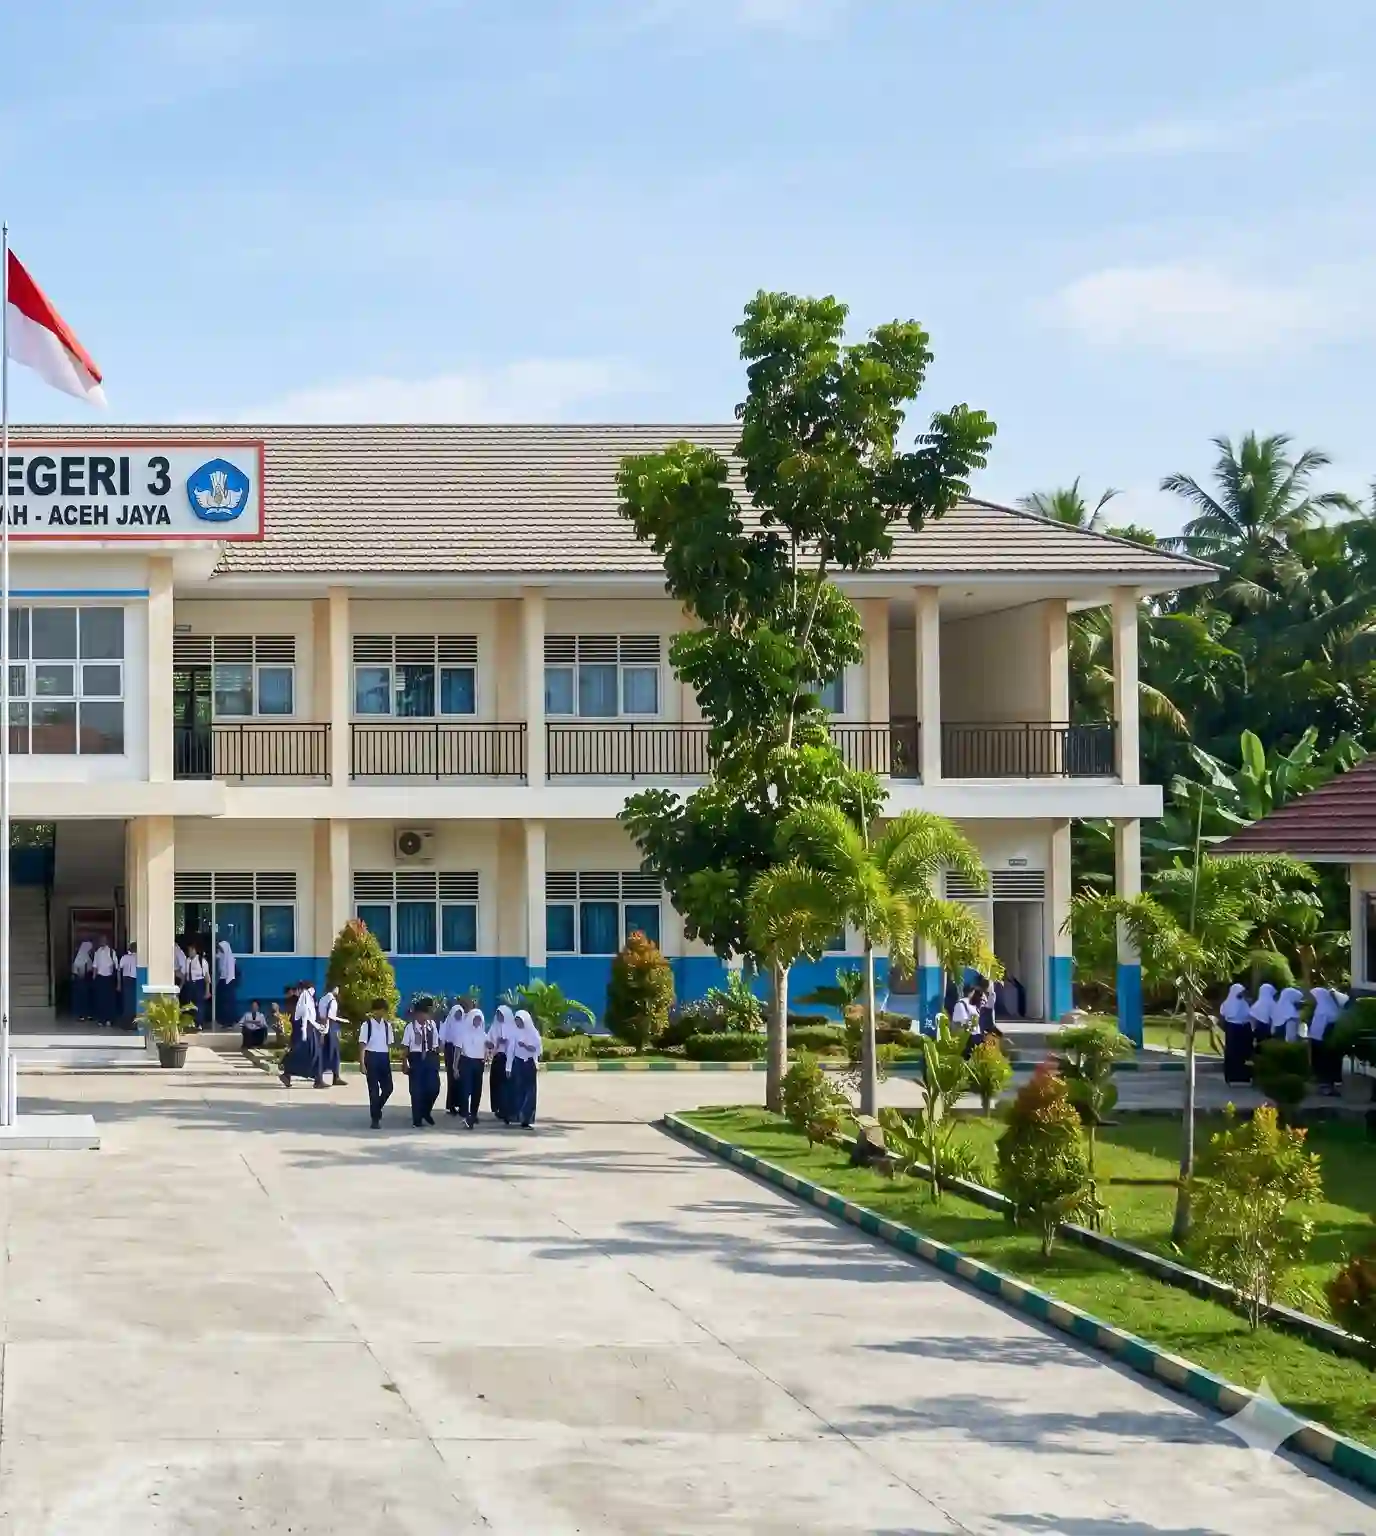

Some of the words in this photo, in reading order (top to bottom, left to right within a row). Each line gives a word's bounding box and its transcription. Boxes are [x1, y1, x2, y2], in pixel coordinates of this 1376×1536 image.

[147, 456, 172, 496] 3
[47, 504, 109, 526] ACEH
[115, 504, 171, 526] JAYA
